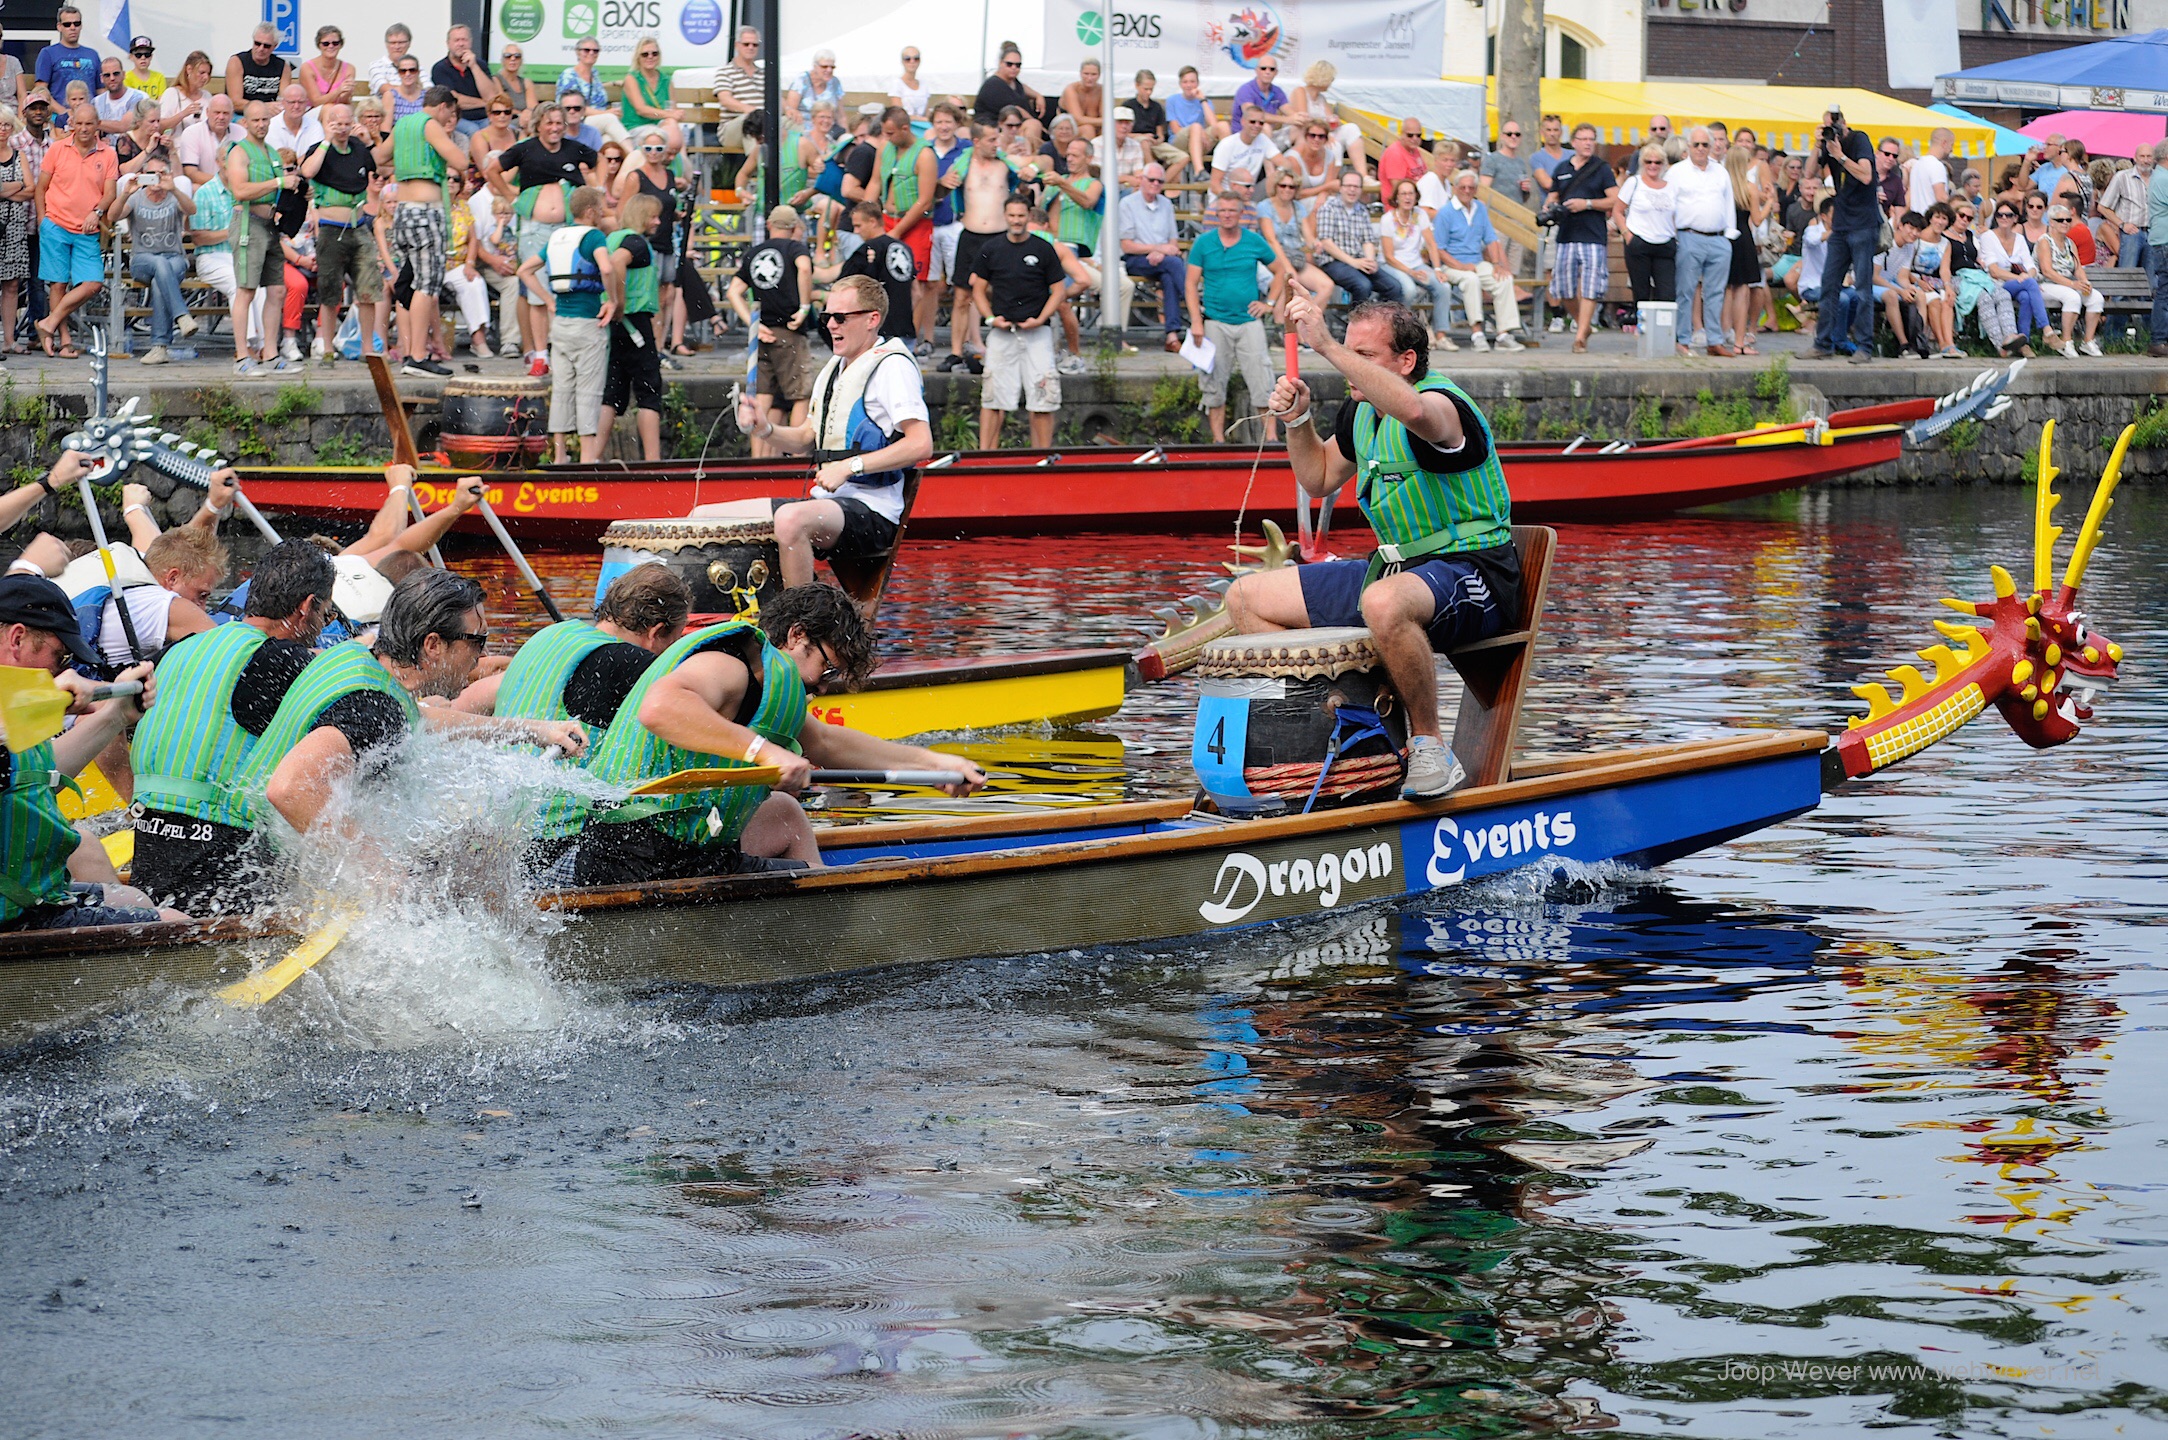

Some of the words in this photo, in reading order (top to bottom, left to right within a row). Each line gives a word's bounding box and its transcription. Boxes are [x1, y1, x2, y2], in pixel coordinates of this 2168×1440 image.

[272, 0, 292, 30] P
[602, 0, 661, 28] axis
[1111, 12, 1161, 38] axis
[1328, 39, 1381, 50] Burgemeester
[513, 482, 599, 513] Events
[1207, 716, 1226, 765] 4
[189, 823, 213, 842] 28
[1199, 842, 1393, 924] Dragon
[1426, 811, 1577, 886] Events
